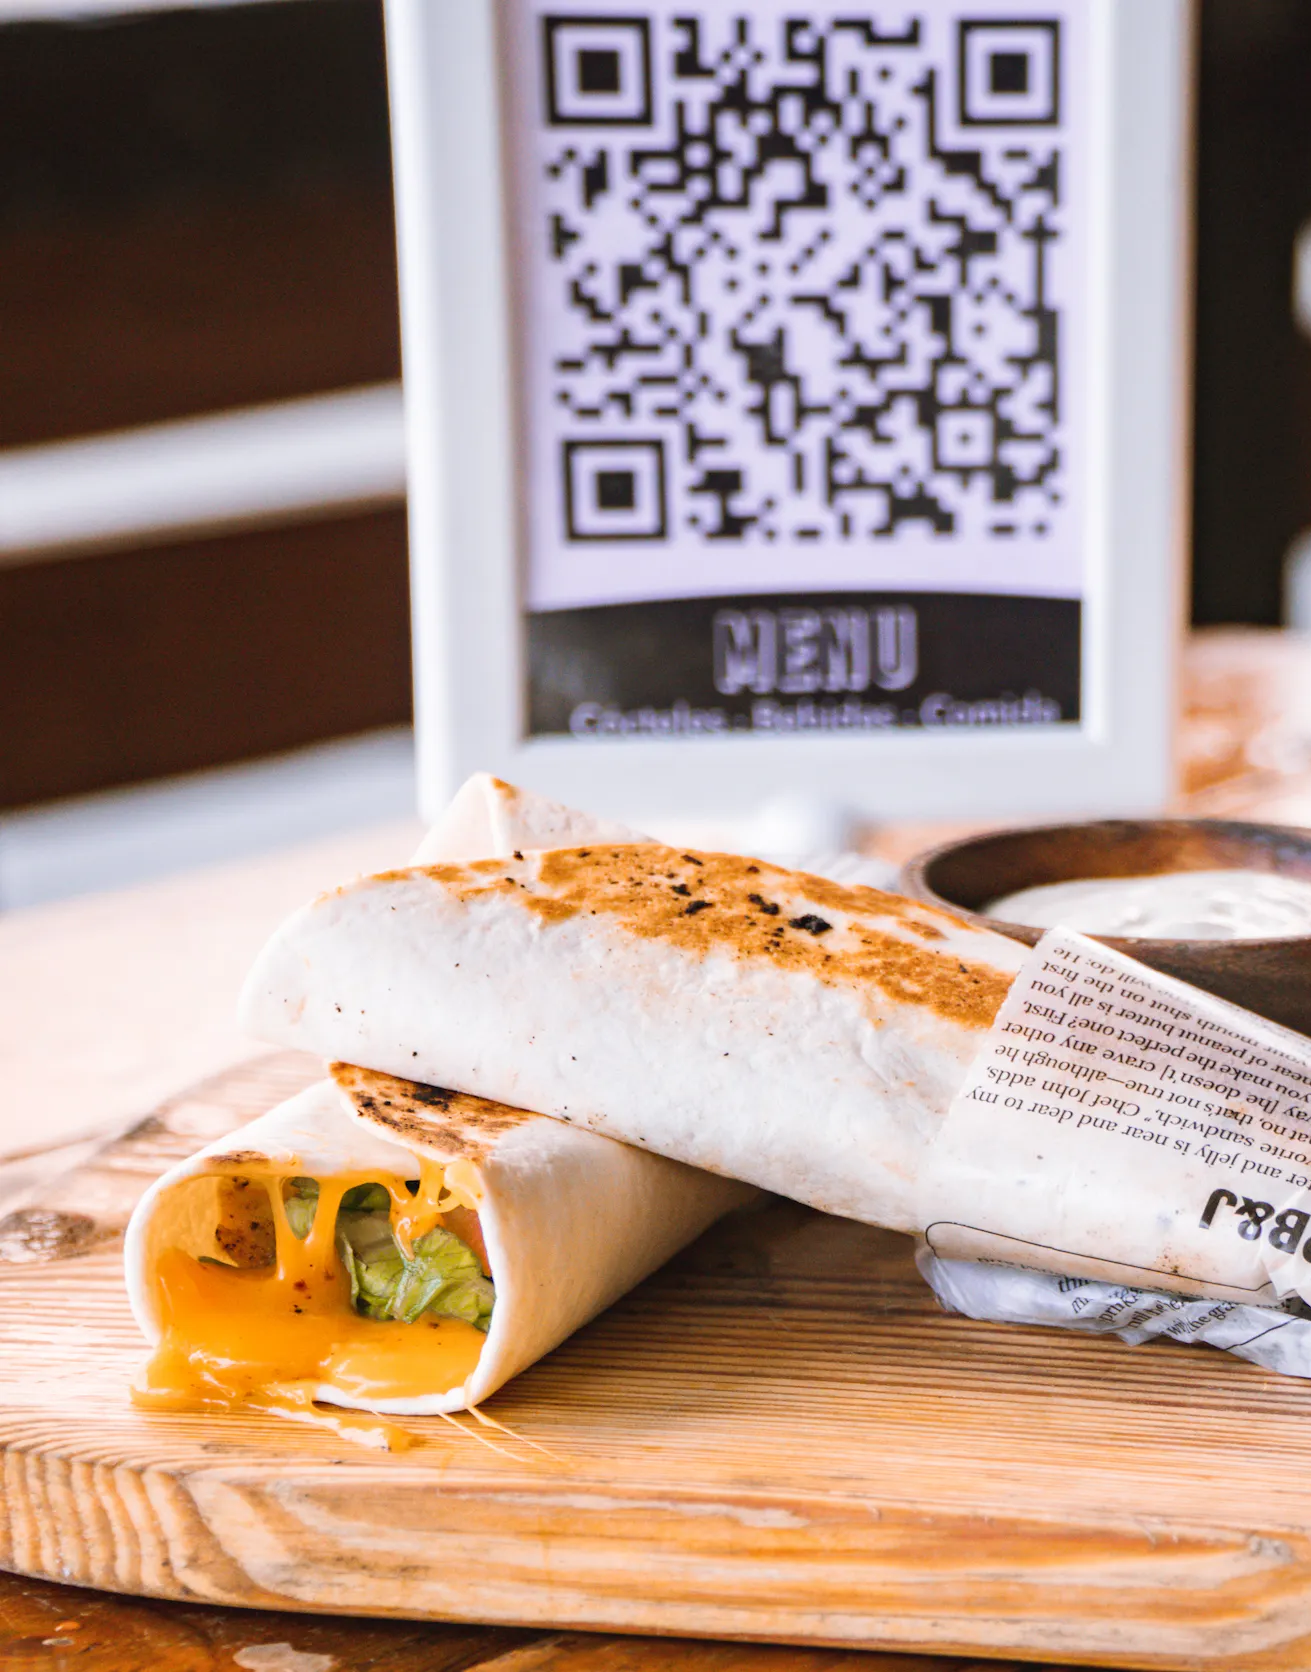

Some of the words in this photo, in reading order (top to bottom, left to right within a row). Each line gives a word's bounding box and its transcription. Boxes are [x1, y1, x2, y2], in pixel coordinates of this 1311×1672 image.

[712, 604, 918, 696] MENU
[1041, 961, 1080, 983] first
[1030, 979, 1069, 999] you
[1083, 977, 1115, 994] the
[1120, 988, 1145, 1003] on
[1067, 991, 1095, 1007] all
[1096, 1001, 1115, 1016] is
[1023, 1000, 1068, 1026] First,
[1149, 999, 1192, 1021] shut
[1001, 1022, 1056, 1044] other
[1067, 1015, 1115, 1036] one?
[1115, 1008, 1176, 1037] butter
[1196, 1017, 1259, 1047] mouth
[994, 1044, 1020, 1063] he
[1058, 1034, 1099, 1055] any
[1116, 1029, 1187, 1059] perfect
[1177, 1028, 1248, 1059] peanut
[1102, 1049, 1157, 1072] crave
[1185, 1052, 1218, 1071] the
[1243, 1054, 1269, 1067] of
[986, 1066, 1037, 1088] adds,
[1219, 1064, 1274, 1089] make
[965, 1085, 1000, 1104] my
[1041, 1080, 1091, 1104] John
[1166, 1091, 1202, 1109] not
[1003, 1097, 1024, 1111] to
[1027, 1102, 1074, 1124] dear
[1087, 1094, 1141, 1117] Chef
[1245, 1094, 1280, 1115] [he
[1076, 1113, 1118, 1132] and
[1259, 1117, 1288, 1136] no,
[1120, 1125, 1170, 1146] near
[1173, 1139, 1191, 1156] is
[1194, 1143, 1241, 1169] jelly
[1240, 1159, 1283, 1179] and
